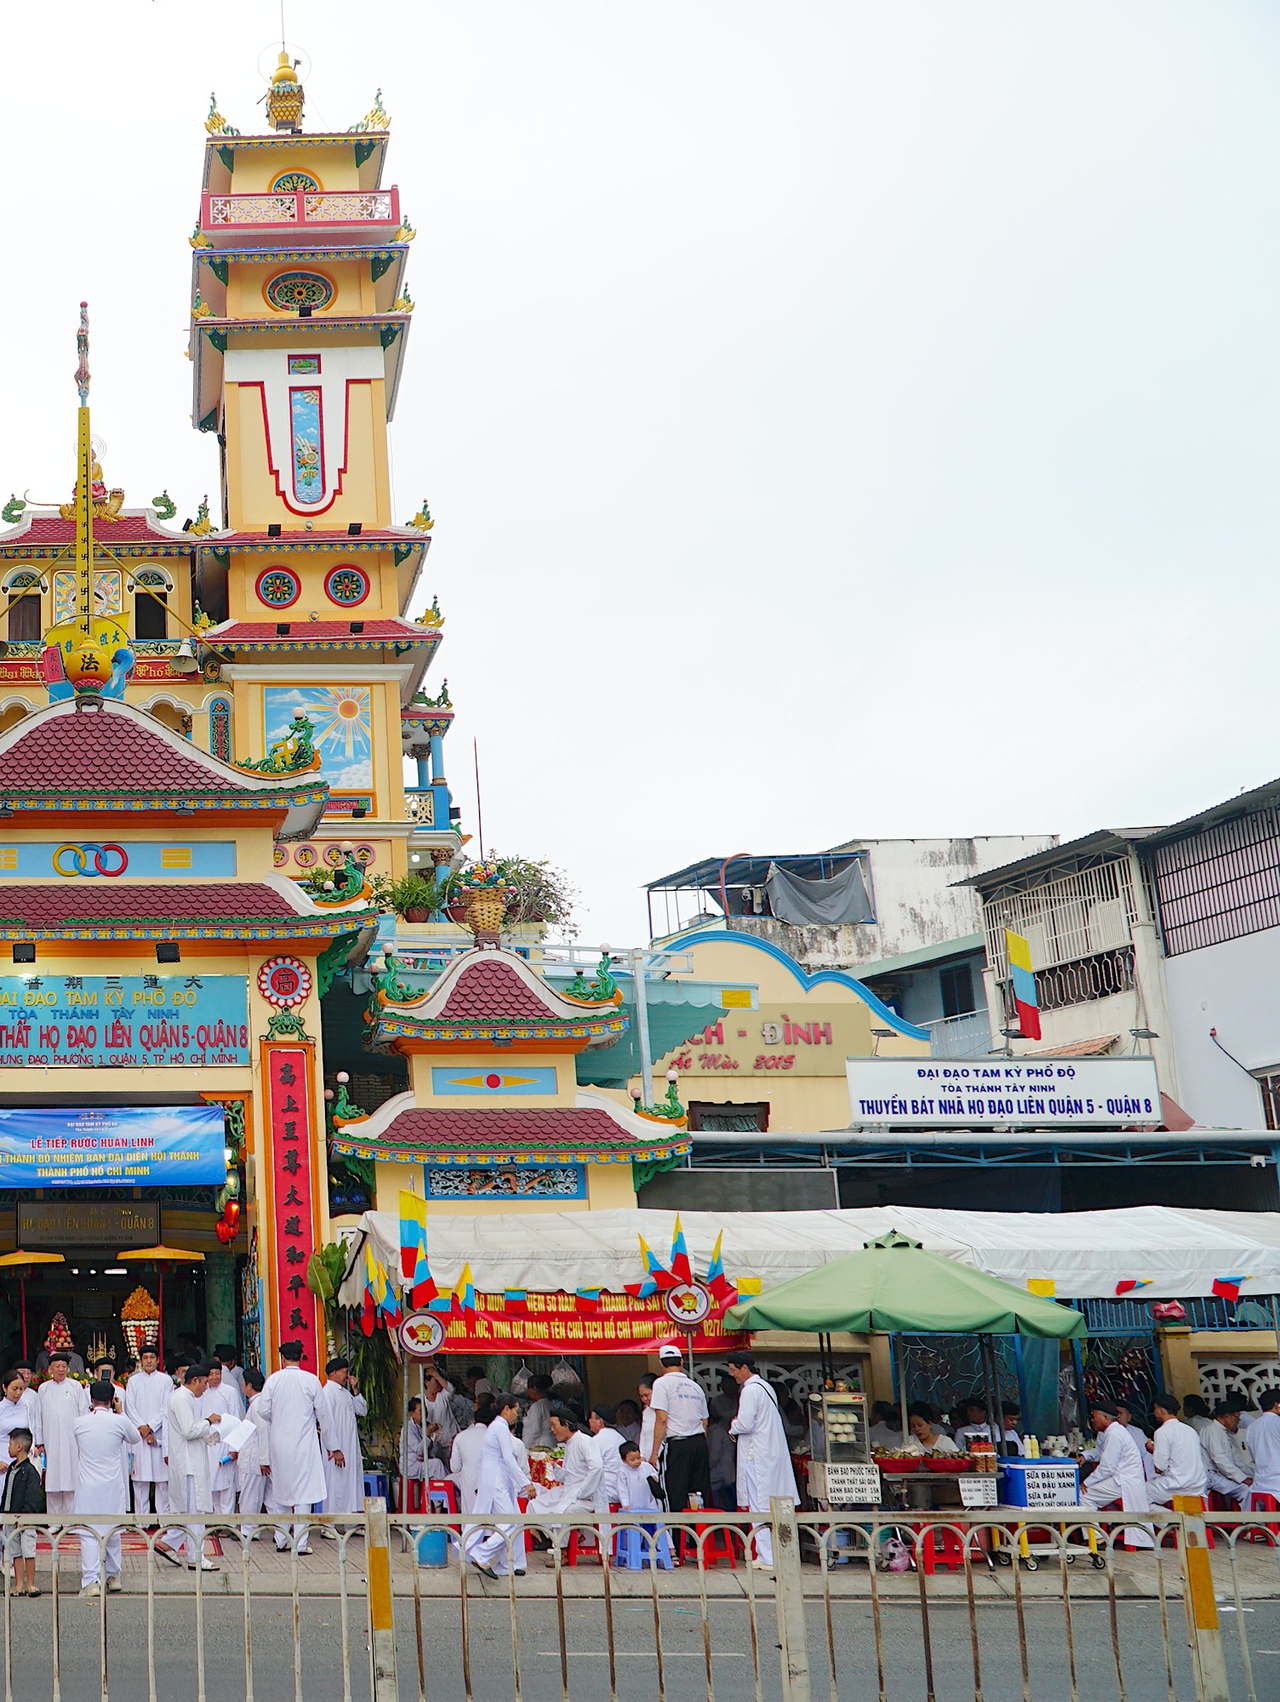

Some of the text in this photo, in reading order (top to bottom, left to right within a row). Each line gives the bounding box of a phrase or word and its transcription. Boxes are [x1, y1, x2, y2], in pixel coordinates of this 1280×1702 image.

[81, 654, 100, 682] 法
[24, 991, 58, 1009] ĐẠO
[66, 991, 98, 1006] TAM
[104, 987, 126, 1006] KỲ
[133, 986, 166, 1006] PHỔ
[172, 988, 198, 1009] ĐỘ
[8, 1007, 180, 1020] TÒA THÁNH TÂY NINH
[39, 1025, 61, 1053] HỌ
[67, 1024, 98, 1053] ĐẠO
[104, 1019, 132, 1049] LIÊN
[762, 1014, 832, 1045] ĐÌNH
[53, 1053, 94, 1065] PHƯỜNG
[109, 1053, 137, 1066] QUẬN
[153, 1055, 165, 1064] TP
[170, 1052, 185, 1064] HỒ
[211, 1054, 238, 1064] MINH
[754, 1054, 796, 1070] 2015
[917, 1063, 1076, 1080] ĐẠI ĐẠO TAM KỲ PHỔ ĐỘ
[941, 1083, 1056, 1093] TÒA THÁNH TÂY NINH
[859, 1094, 1152, 1118] THUYỀN BÁT NHÃ HỌ ĐẠO LIÊN QUẬN 5 QUẬN 8
[46, 1135, 68, 1149] TIẾP
[70, 1136, 97, 1149] RƯỚC
[101, 1134, 128, 1148] HUẤN
[131, 1136, 154, 1149] LỊNH
[5, 1152, 35, 1163] THÁNH
[53, 1152, 83, 1164] NHIỆM
[86, 1152, 105, 1163] BAN
[108, 1152, 123, 1164] ĐẠI
[151, 1150, 166, 1162] HỘI
[169, 1150, 199, 1161] THÁNH
[37, 1164, 150, 1177] THÀNH PHỐ HỒ CHÍ MINH
[492, 1316, 653, 1343] VINH DỰ MANG TÊN CHỦ TỊCH HỒ CHÍ MINH
